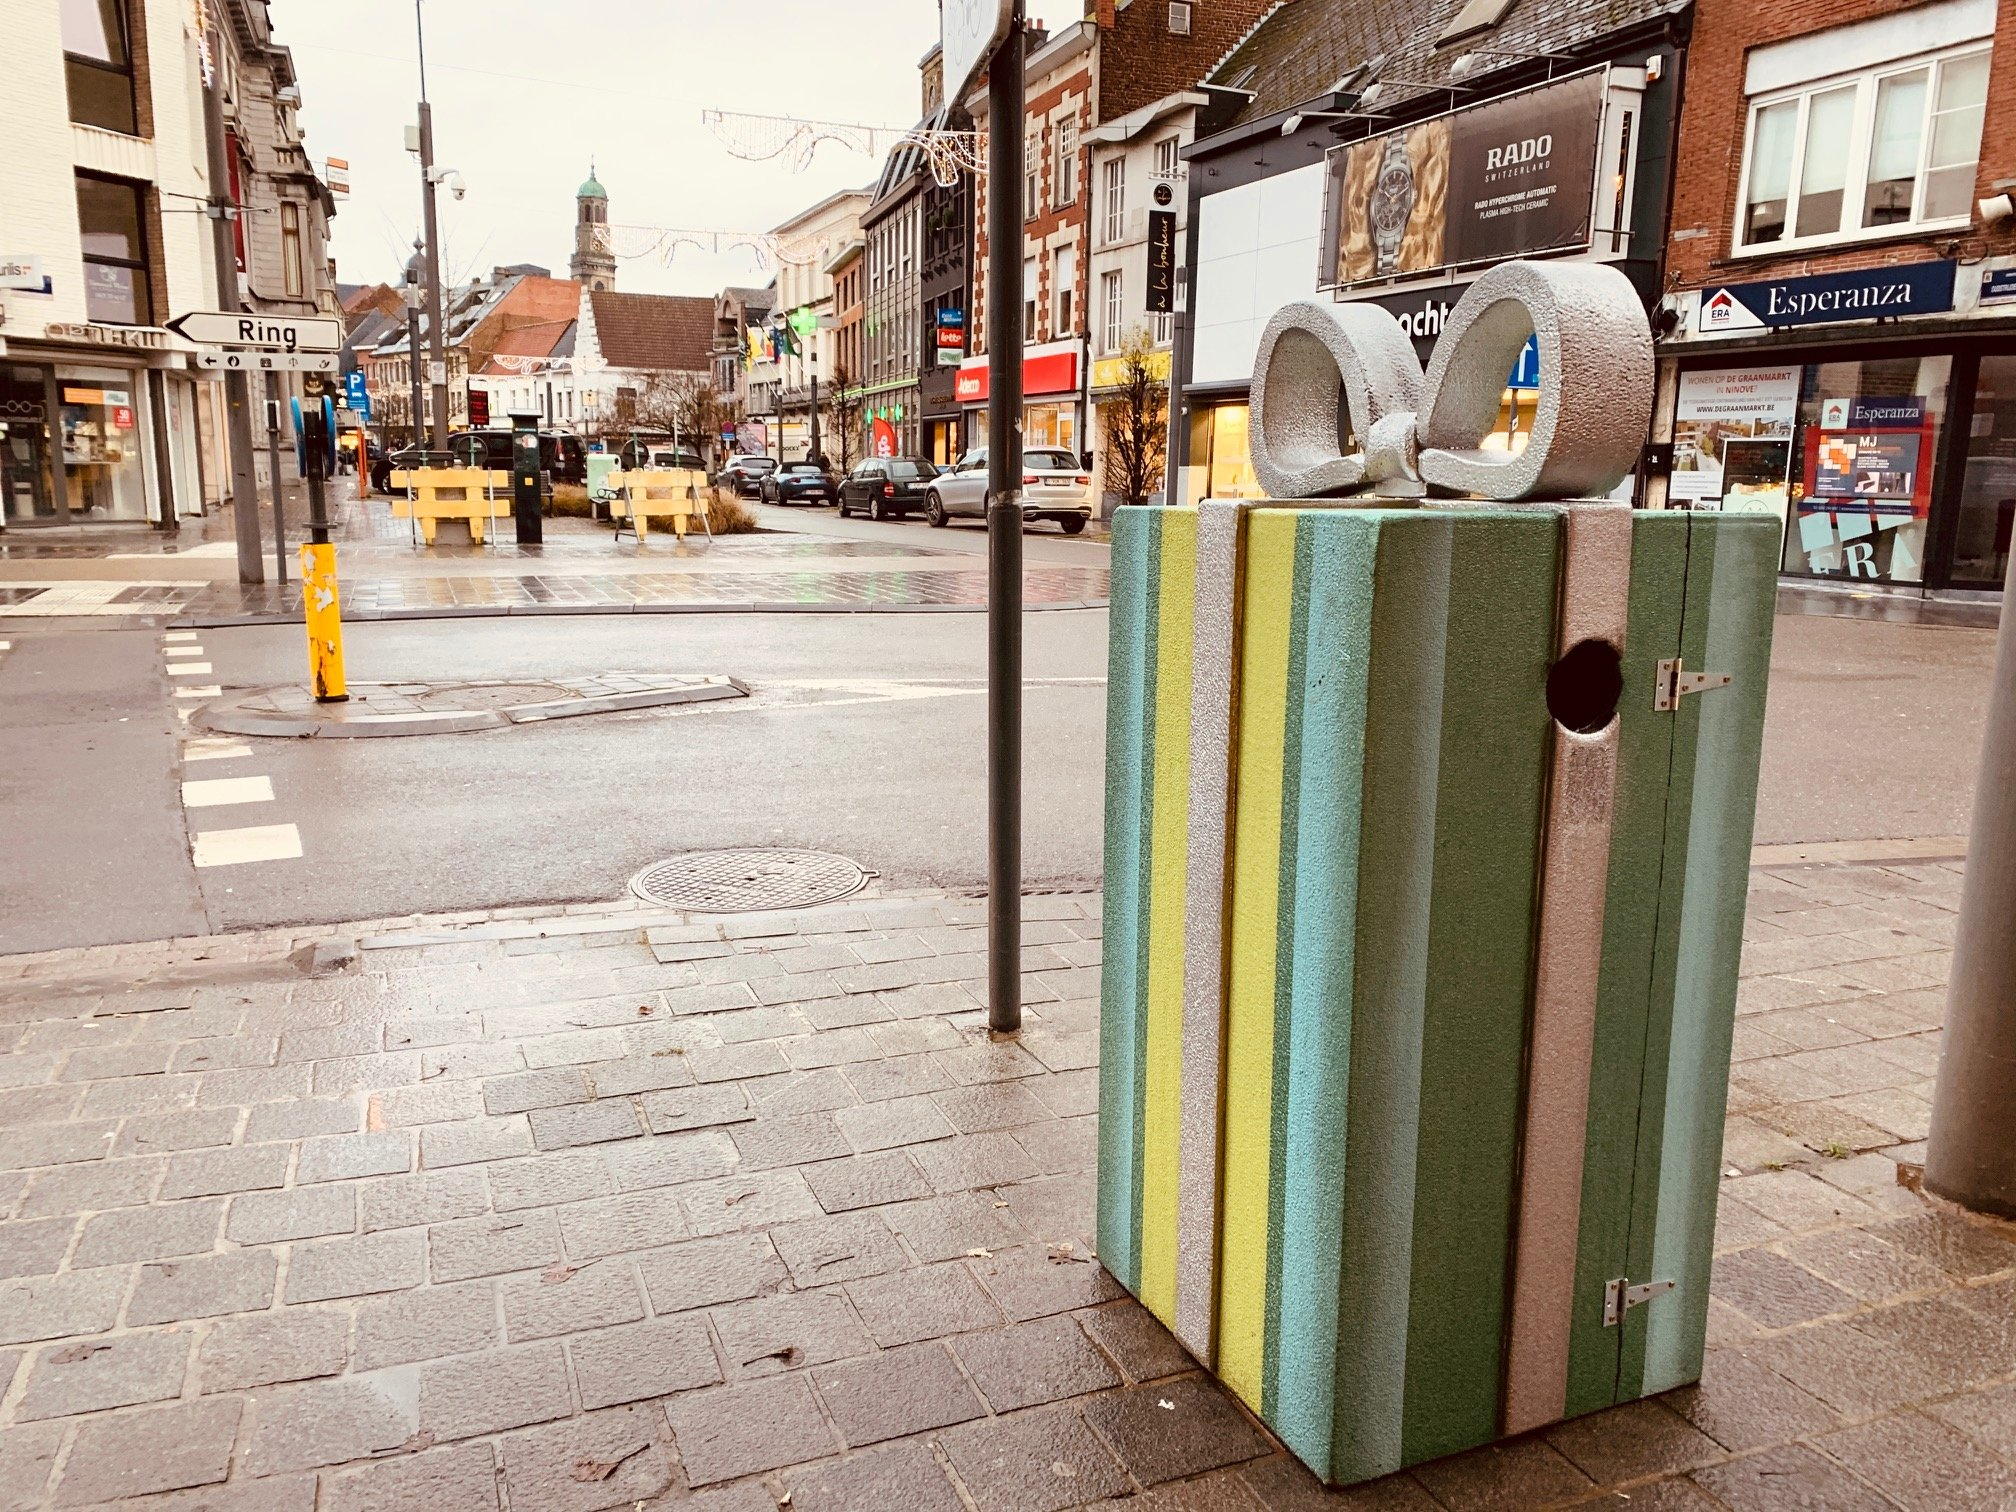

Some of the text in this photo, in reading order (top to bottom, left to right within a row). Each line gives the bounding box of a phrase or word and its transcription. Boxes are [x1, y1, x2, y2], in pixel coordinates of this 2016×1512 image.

[1486, 134, 1552, 170] RADO
[1485, 160, 1550, 183] SWITZERLAND
[1474, 184, 1557, 210] RADO HYPERCHROME AUTOMATIC
[1480, 197, 1549, 220] PLASMA HIGH-TECH CERAMIC
[1153, 272, 1169, 290] la
[1767, 283, 1912, 317] Esperanza
[1711, 308, 1730, 319] ERA
[238, 319, 297, 349] Ring
[350, 374, 361, 389] P
[958, 376, 980, 394] Adecco
[1688, 372, 1792, 385] WONEN OP DE GRAANMARKT
[1716, 386, 1724, 394] IN
[1696, 404, 1775, 413] WWW.DEGRAANMARKT.BE
[1855, 405, 1920, 423] Esperanza
[1859, 436, 1878, 448] MJ
